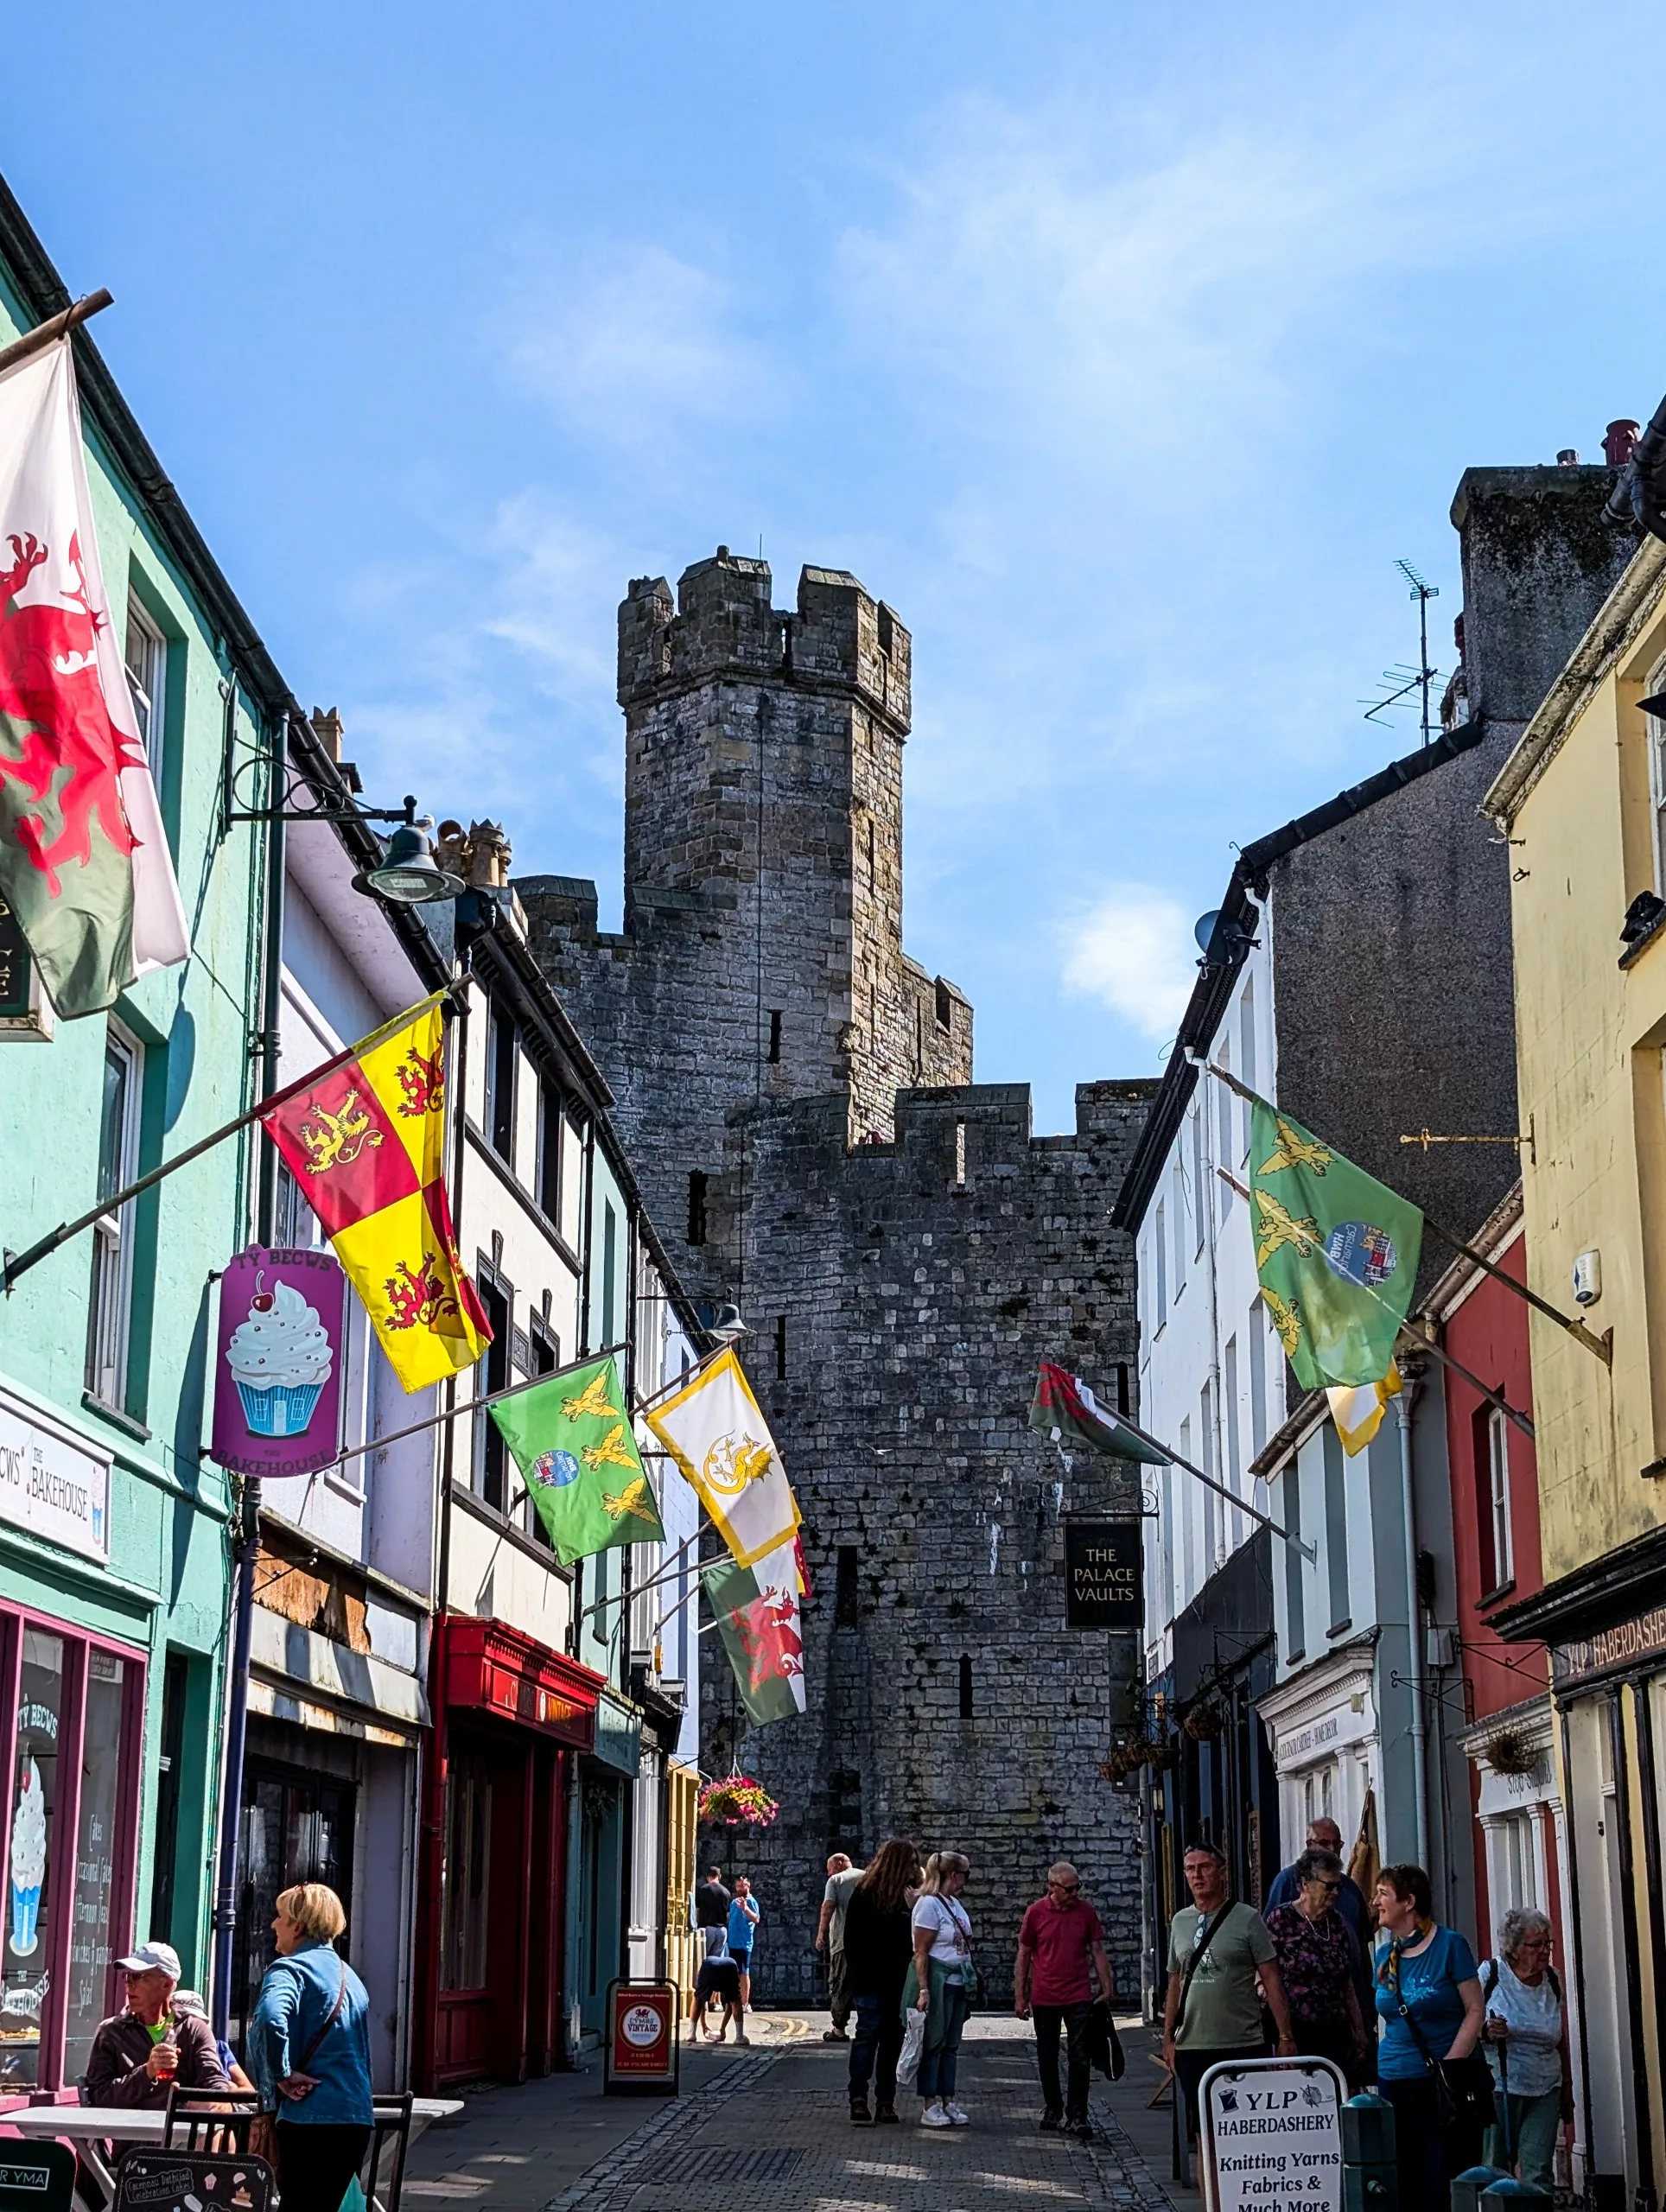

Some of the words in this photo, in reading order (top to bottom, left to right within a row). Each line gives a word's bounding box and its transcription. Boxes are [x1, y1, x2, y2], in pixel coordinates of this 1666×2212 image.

[269, 1250, 330, 1271] BECWS
[33, 1446, 43, 1464] THE
[215, 1448, 330, 1476] BAKEHOUSE
[31, 1465, 88, 1522] BAKEHOUSE
[1085, 1548, 1117, 1562] THE
[1074, 1568, 1135, 1582] PALACE
[1074, 1587, 1135, 1601] VAULTS
[1567, 1642, 1587, 1675] YLP
[1592, 1608, 1666, 1668] HABERDASHE
[30, 1704, 59, 1739] BECWS
[17, 1970, 28, 1982] THE
[627, 2024, 658, 2032] VINTAGE
[1245, 2091, 1298, 2111] YLP
[1218, 2114, 1335, 2136] HABERDASHERY
[1219, 2153, 1288, 2172] Knitting
[1291, 2152, 1339, 2167] Yarns
[13, 2171, 45, 2185] YMA
[1242, 2176, 1303, 2195] Fabrics
[1307, 2175, 1321, 2190] &
[1238, 2199, 1282, 2212] Much
[1288, 2201, 1330, 2212] More
